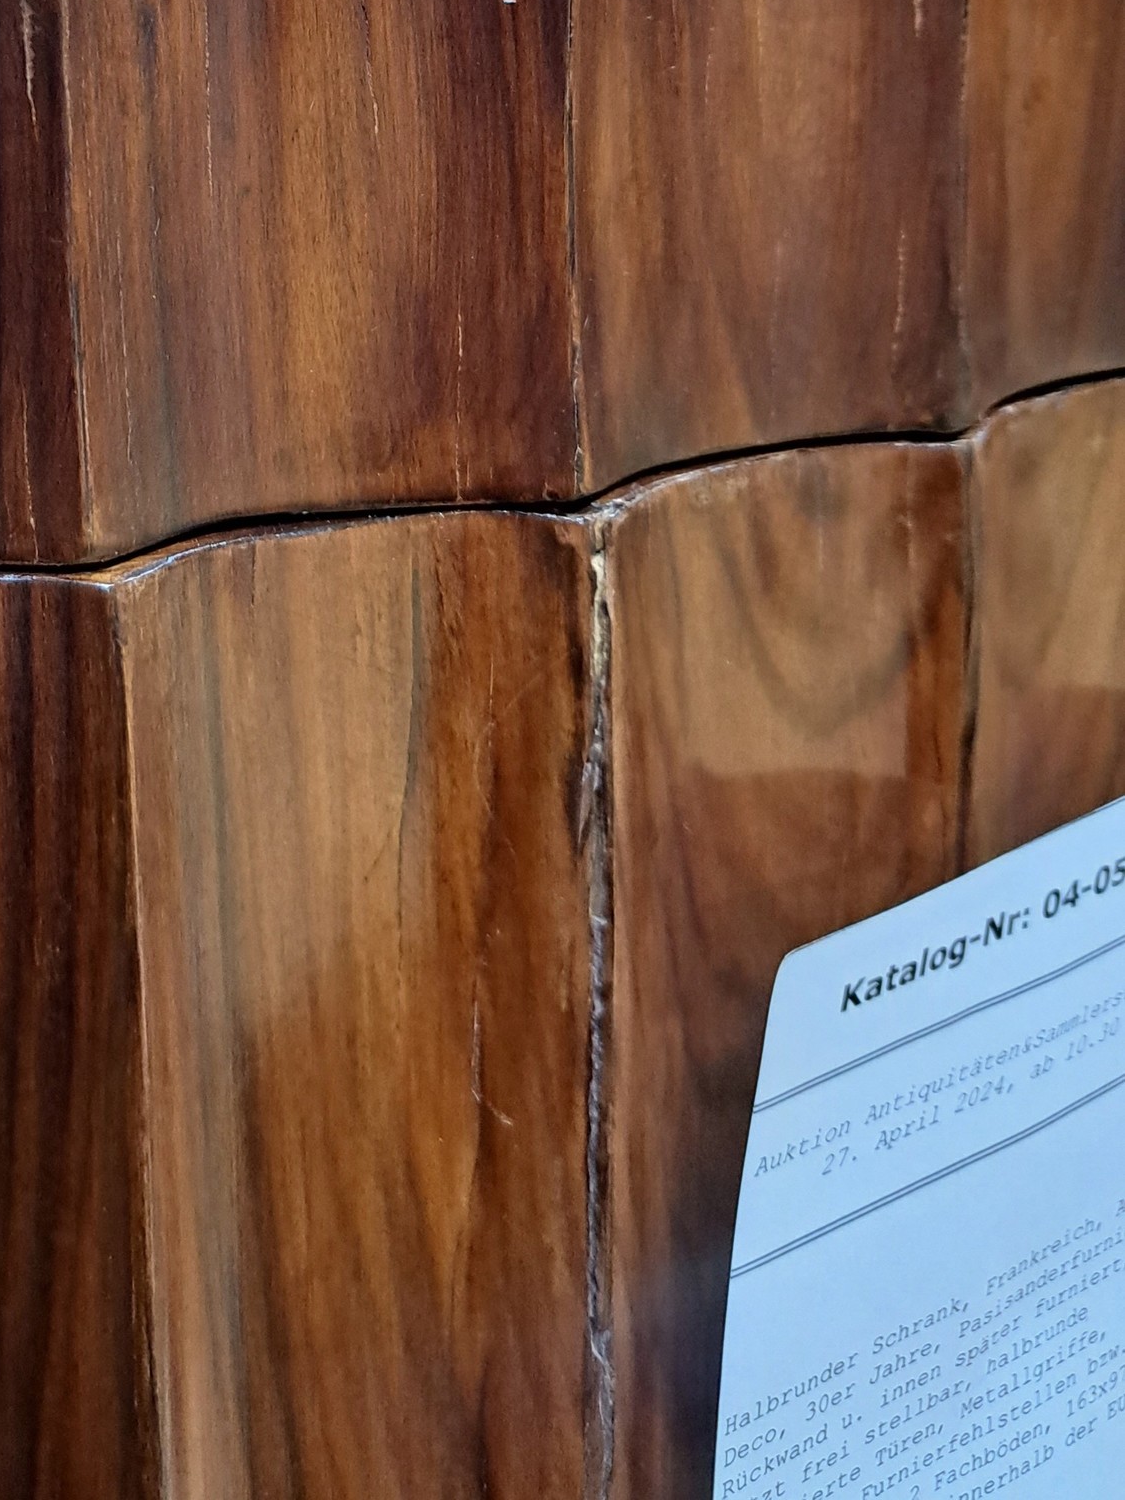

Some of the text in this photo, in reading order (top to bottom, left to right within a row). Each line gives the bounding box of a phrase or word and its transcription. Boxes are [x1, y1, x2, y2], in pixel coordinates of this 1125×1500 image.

[840, 906, 1031, 1013] Katalog-Nr:
[754, 991, 1125, 1177] Auktion Antiquitäten&Sammlers
[821, 1146, 858, 1176] 27.
[875, 1105, 939, 1150] April
[954, 1075, 1014, 1113] 2024,
[1029, 1055, 1055, 1079] ab
[725, 1352, 859, 1436] Halbrunder
[872, 1298, 969, 1355] Schrank,
[986, 1218, 1102, 1296] Frankreich,
[721, 1423, 829, 1500] Rückwand
[841, 1412, 863, 1429] u.
[880, 1364, 942, 1409] innen
[955, 1314, 1023, 1367] später
[724, 1428, 786, 1468] Deco,
[805, 1382, 856, 1422] 30er
[869, 1341, 941, 1385] Jahre,
[801, 1440, 850, 1484] frei
[864, 1379, 972, 1445] stellbar,
[986, 1306, 1089, 1375] halbrunde
[861, 1371, 1077, 1500] Furnierfehlstellen
[875, 1422, 944, 1468] Türen,
[959, 1329, 1106, 1419] Metallgriffe,
[933, 1423, 1051, 1492] Fachböden,
[950, 1444, 1055, 1500] nnerhalb
[1064, 1416, 1099, 1448] der
